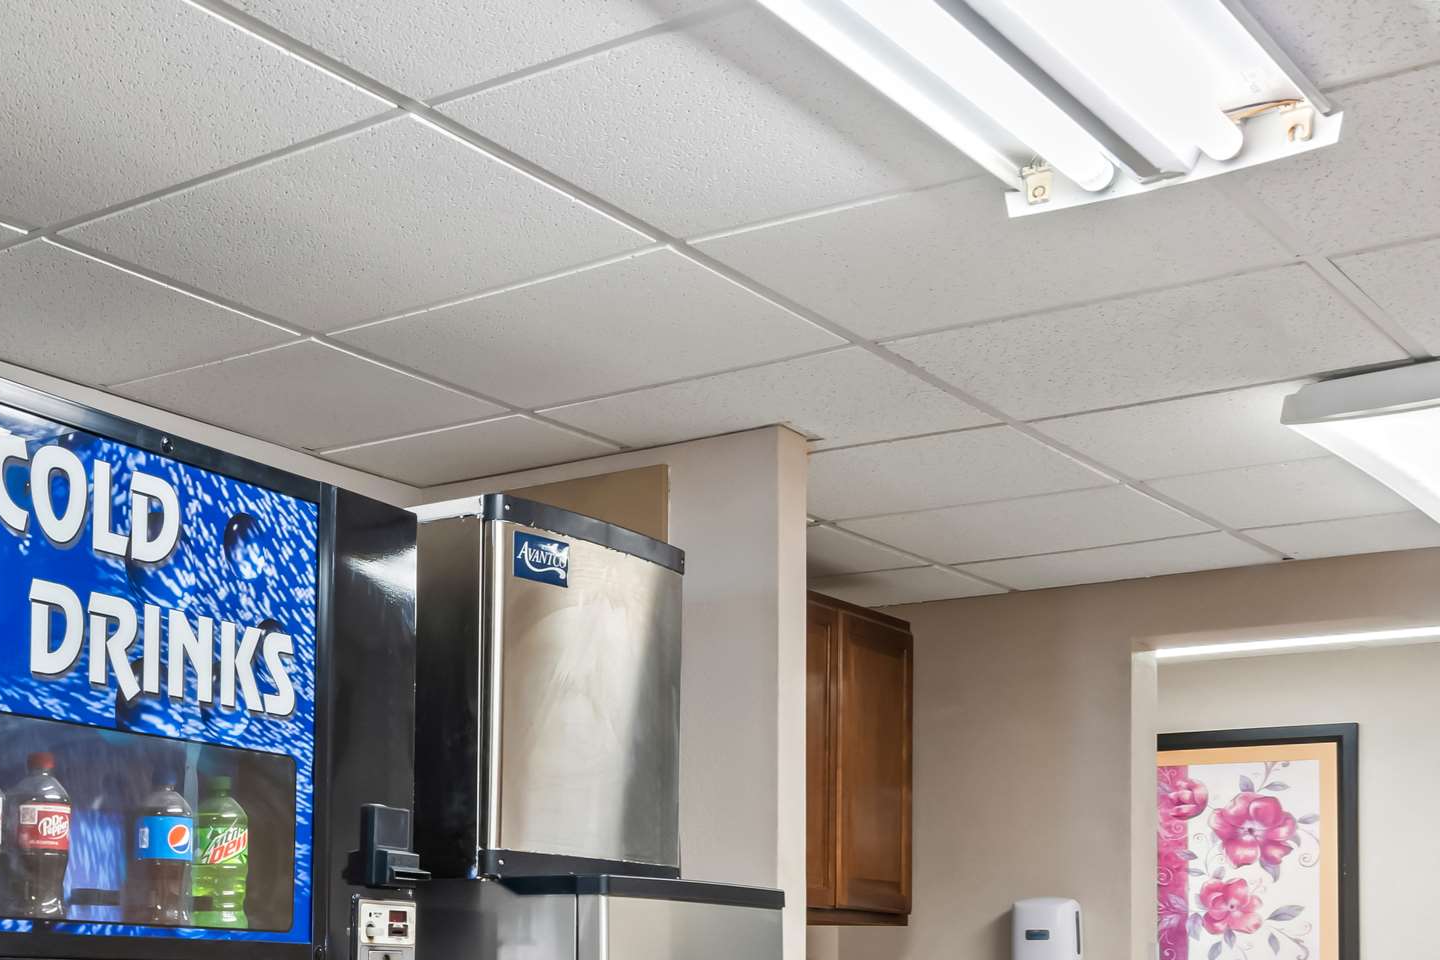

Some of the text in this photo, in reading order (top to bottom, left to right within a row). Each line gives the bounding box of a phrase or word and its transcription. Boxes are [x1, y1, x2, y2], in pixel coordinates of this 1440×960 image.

[516, 541, 567, 580] AVANTCO
[28, 577, 297, 717] DRINKS
[52, 814, 64, 824] Dr
